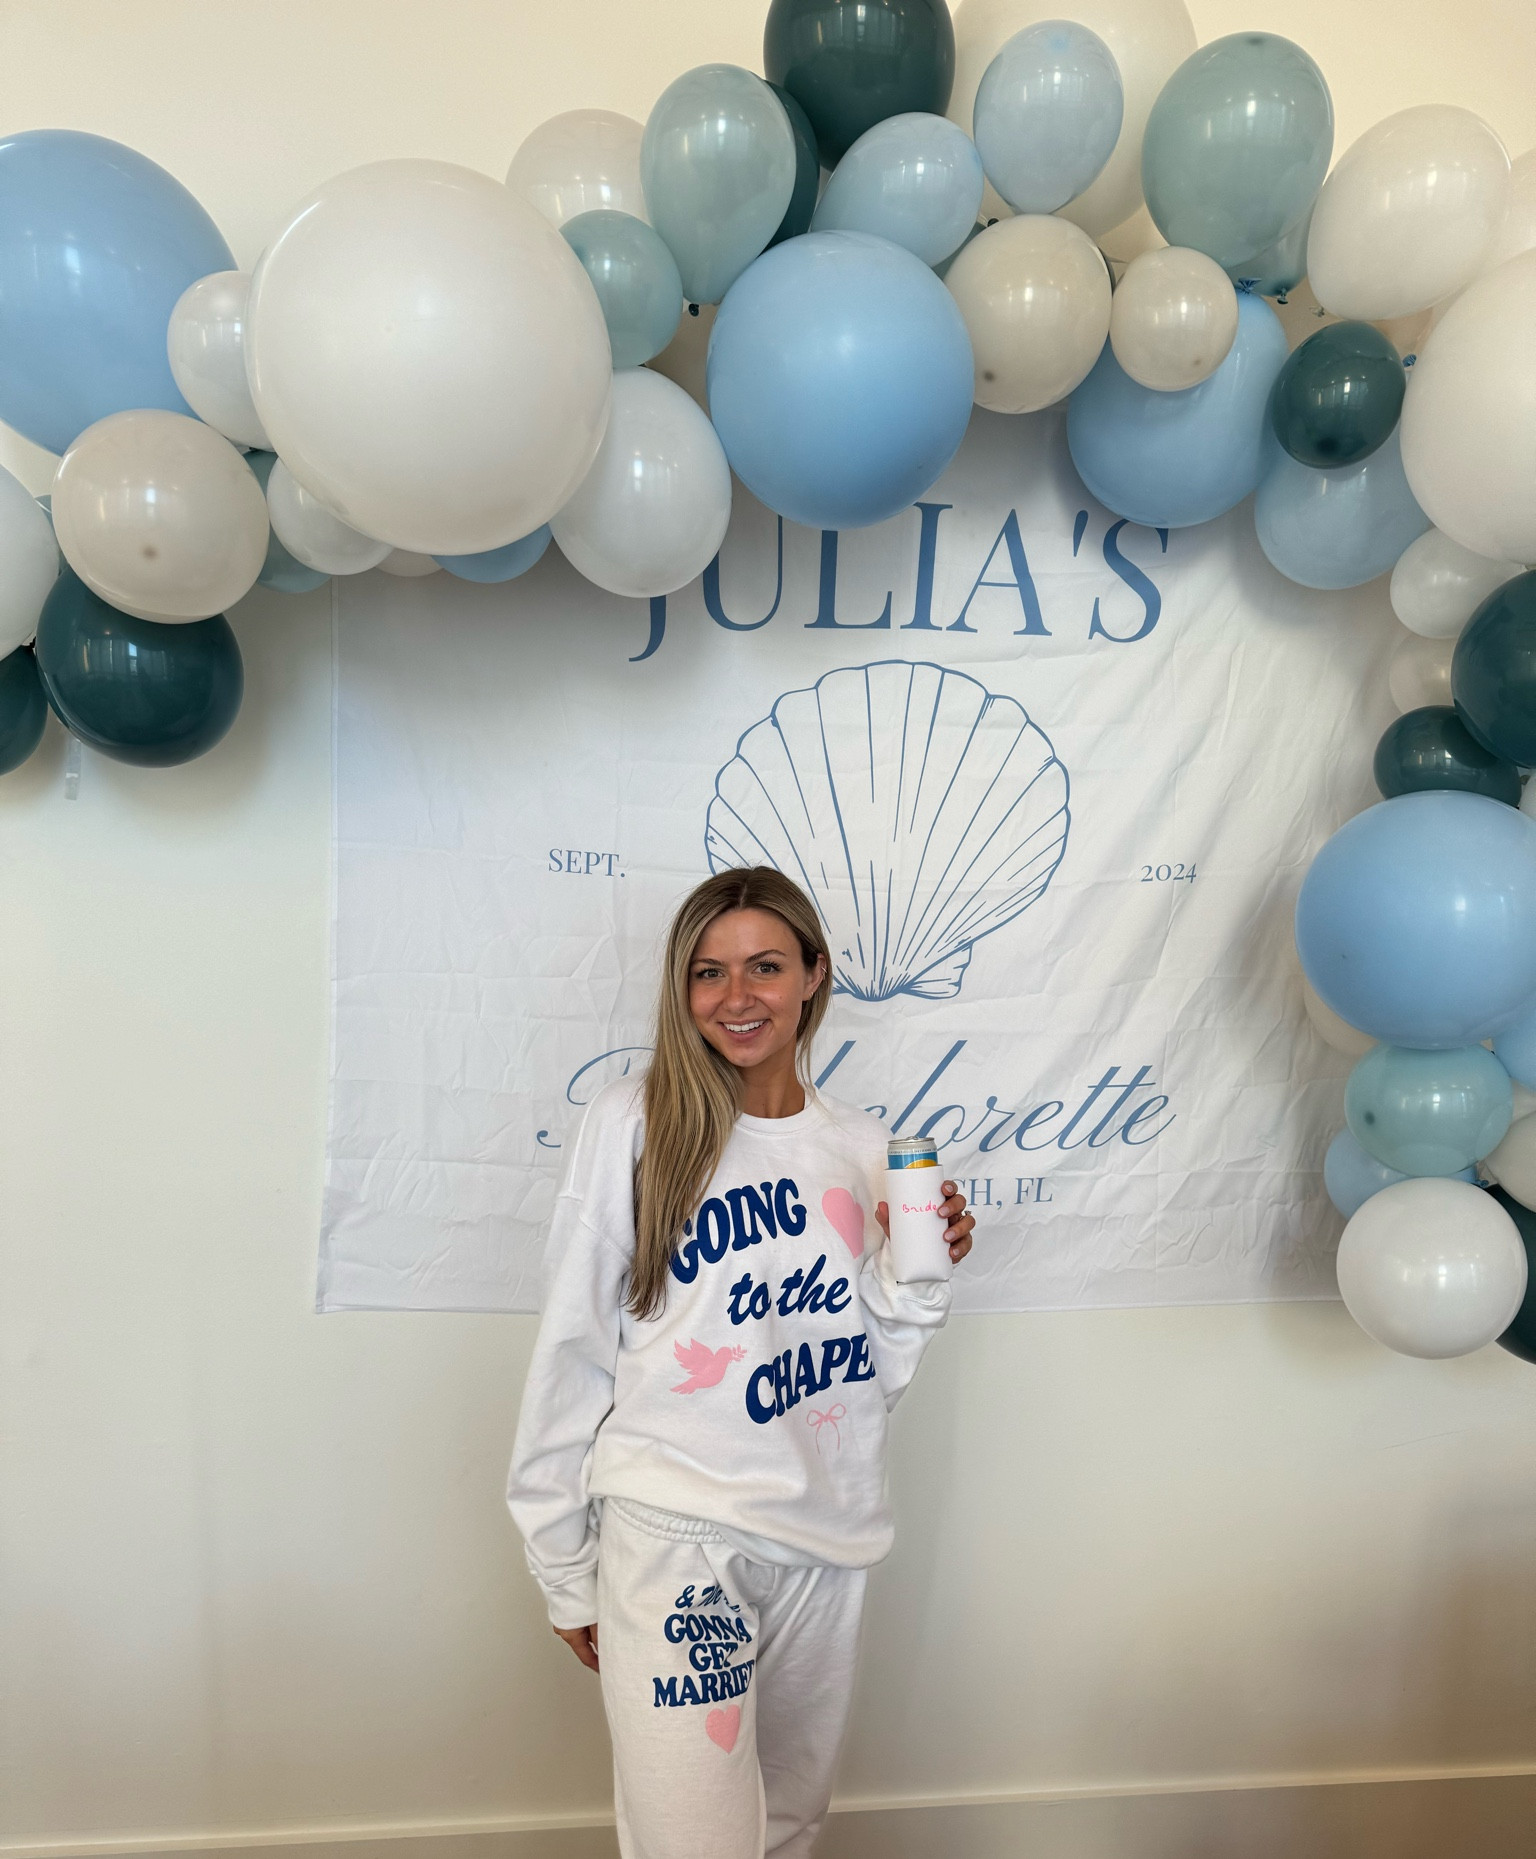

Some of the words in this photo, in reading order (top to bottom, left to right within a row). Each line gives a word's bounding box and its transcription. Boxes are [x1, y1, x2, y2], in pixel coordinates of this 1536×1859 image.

[548, 848, 626, 878] SEPT.
[1140, 862, 1197, 884] 2024
[536, 1039, 1177, 1153] lorette
[1014, 1176, 1053, 1205] FL
[902, 1199, 937, 1214] Bride
[727, 1272, 772, 1326] to
[776, 1254, 852, 1317] the
[745, 1332, 877, 1425] CHAPE
[675, 1584, 696, 1609] &
[664, 1613, 753, 1644] GONNA
[688, 1642, 739, 1672] GET
